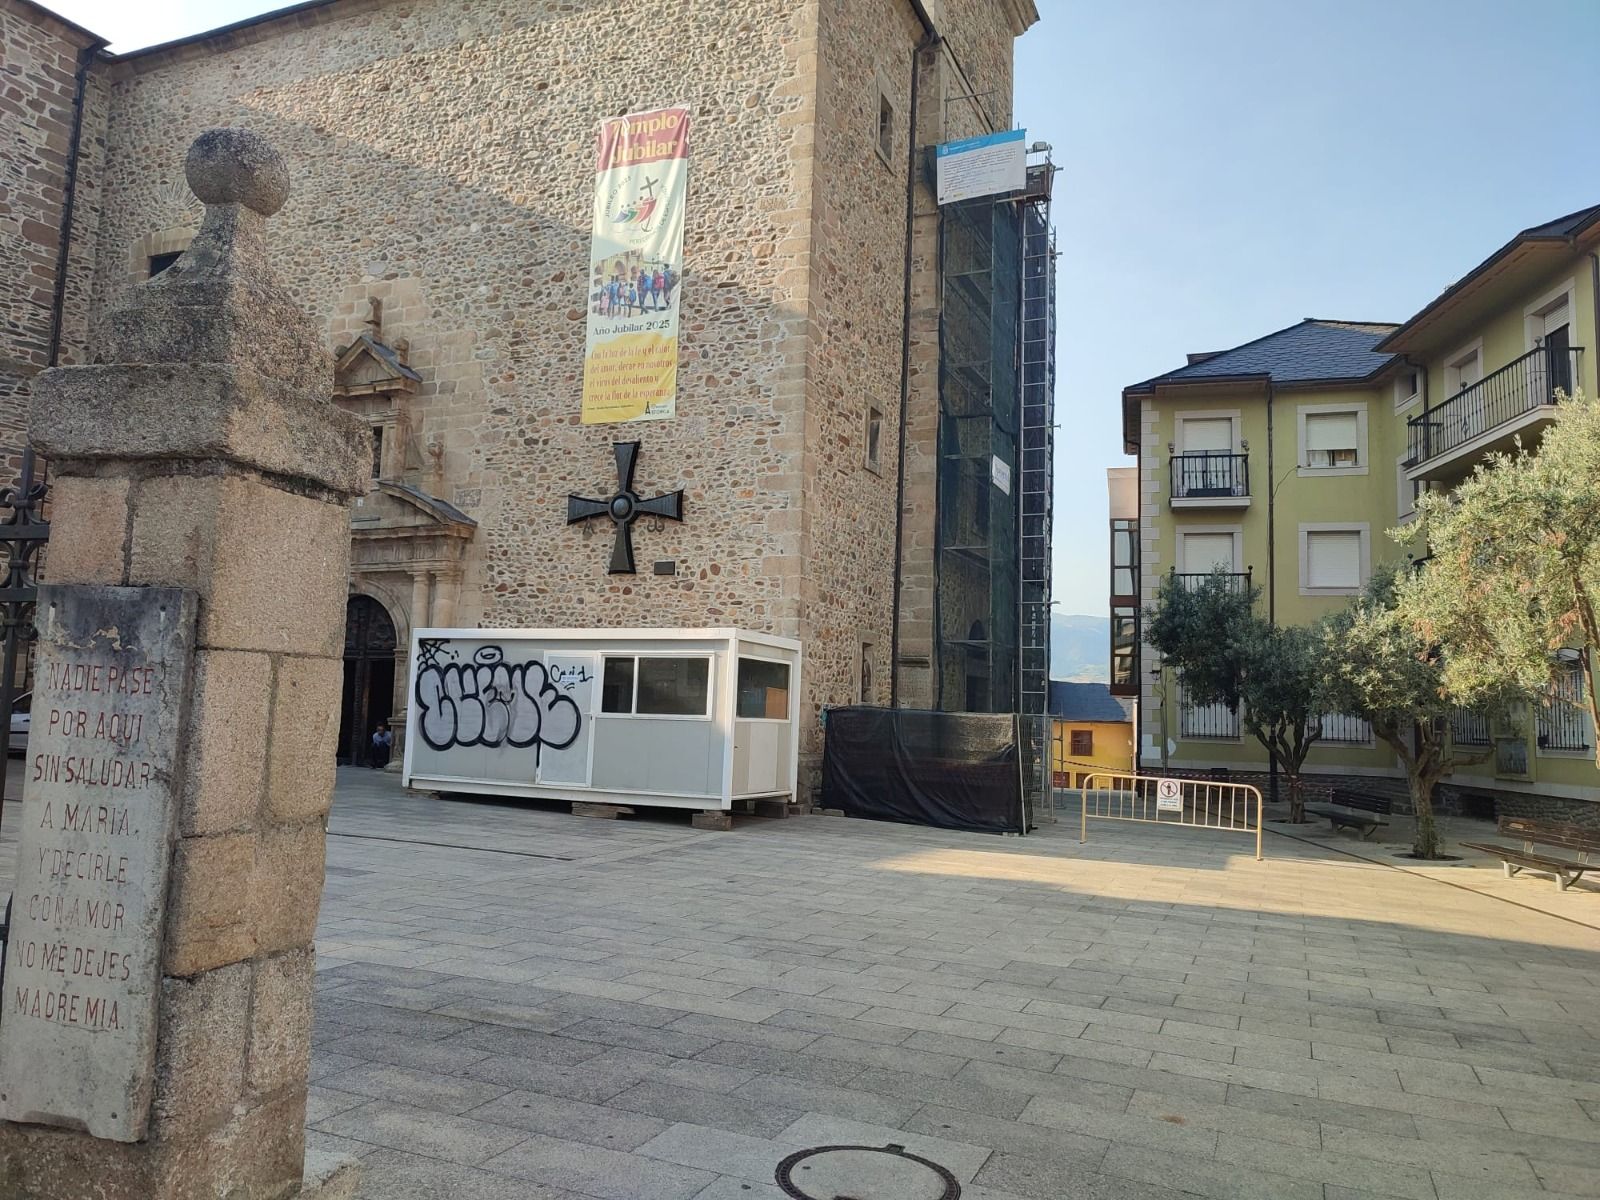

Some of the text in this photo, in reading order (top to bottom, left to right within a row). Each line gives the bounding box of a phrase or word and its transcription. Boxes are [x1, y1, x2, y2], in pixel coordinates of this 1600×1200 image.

[593, 320, 670, 336] Año Jubilar 2025
[611, 376, 620, 386] del
[48, 662, 154, 696] NADIE PASE
[48, 709, 143, 743] POR AQUI
[32, 753, 151, 789] SIN SALUDAR
[40, 801, 53, 829] A
[38, 847, 129, 884] Y DECIRLE
[29, 894, 125, 932] CON AMOR
[16, 940, 132, 982] NO ME DEJES
[15, 987, 125, 1030] MADRE MIA.
